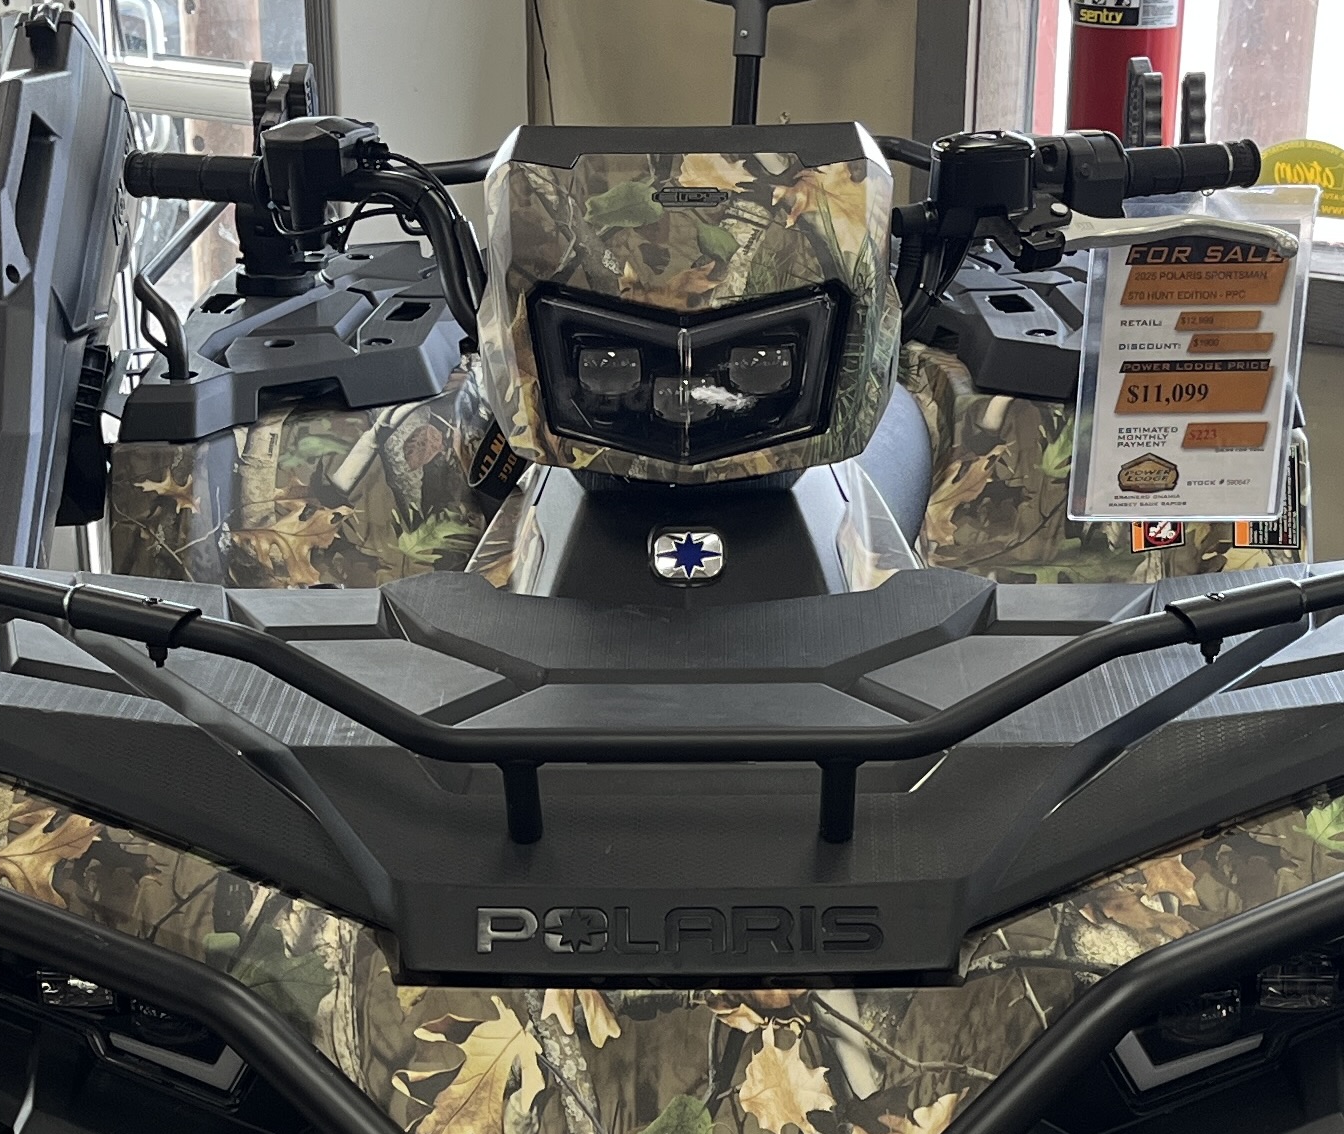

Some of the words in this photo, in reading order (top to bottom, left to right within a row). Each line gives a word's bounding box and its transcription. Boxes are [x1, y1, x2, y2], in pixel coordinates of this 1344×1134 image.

[1080, 8, 1124, 24] sentry
[1127, 246, 1192, 264] FOR
[1203, 245, 1285, 264] SALE
[1135, 271, 1158, 281] 2025
[1160, 271, 1202, 280] POLARIS
[1205, 270, 1268, 280] SPORTSMAN
[1128, 291, 1145, 300] 570
[1147, 291, 1174, 300] HUNT
[1177, 290, 1218, 300] EDITION
[1225, 290, 1246, 299] PPC
[1120, 319, 1163, 327] RETAIL:
[1118, 343, 1182, 351] DISCOUNT:
[1122, 362, 1171, 372] POWER
[1175, 362, 1223, 371] LODGE
[1227, 360, 1269, 370] PRICE
[1127, 383, 1209, 406] $11,099
[1118, 426, 1179, 434] ESTIMATED
[1189, 429, 1217, 441] $223
[1117, 433, 1169, 441] MONTHLY
[1117, 440, 1167, 448] PAYMENT
[475, 905, 885, 955] POLARIS
